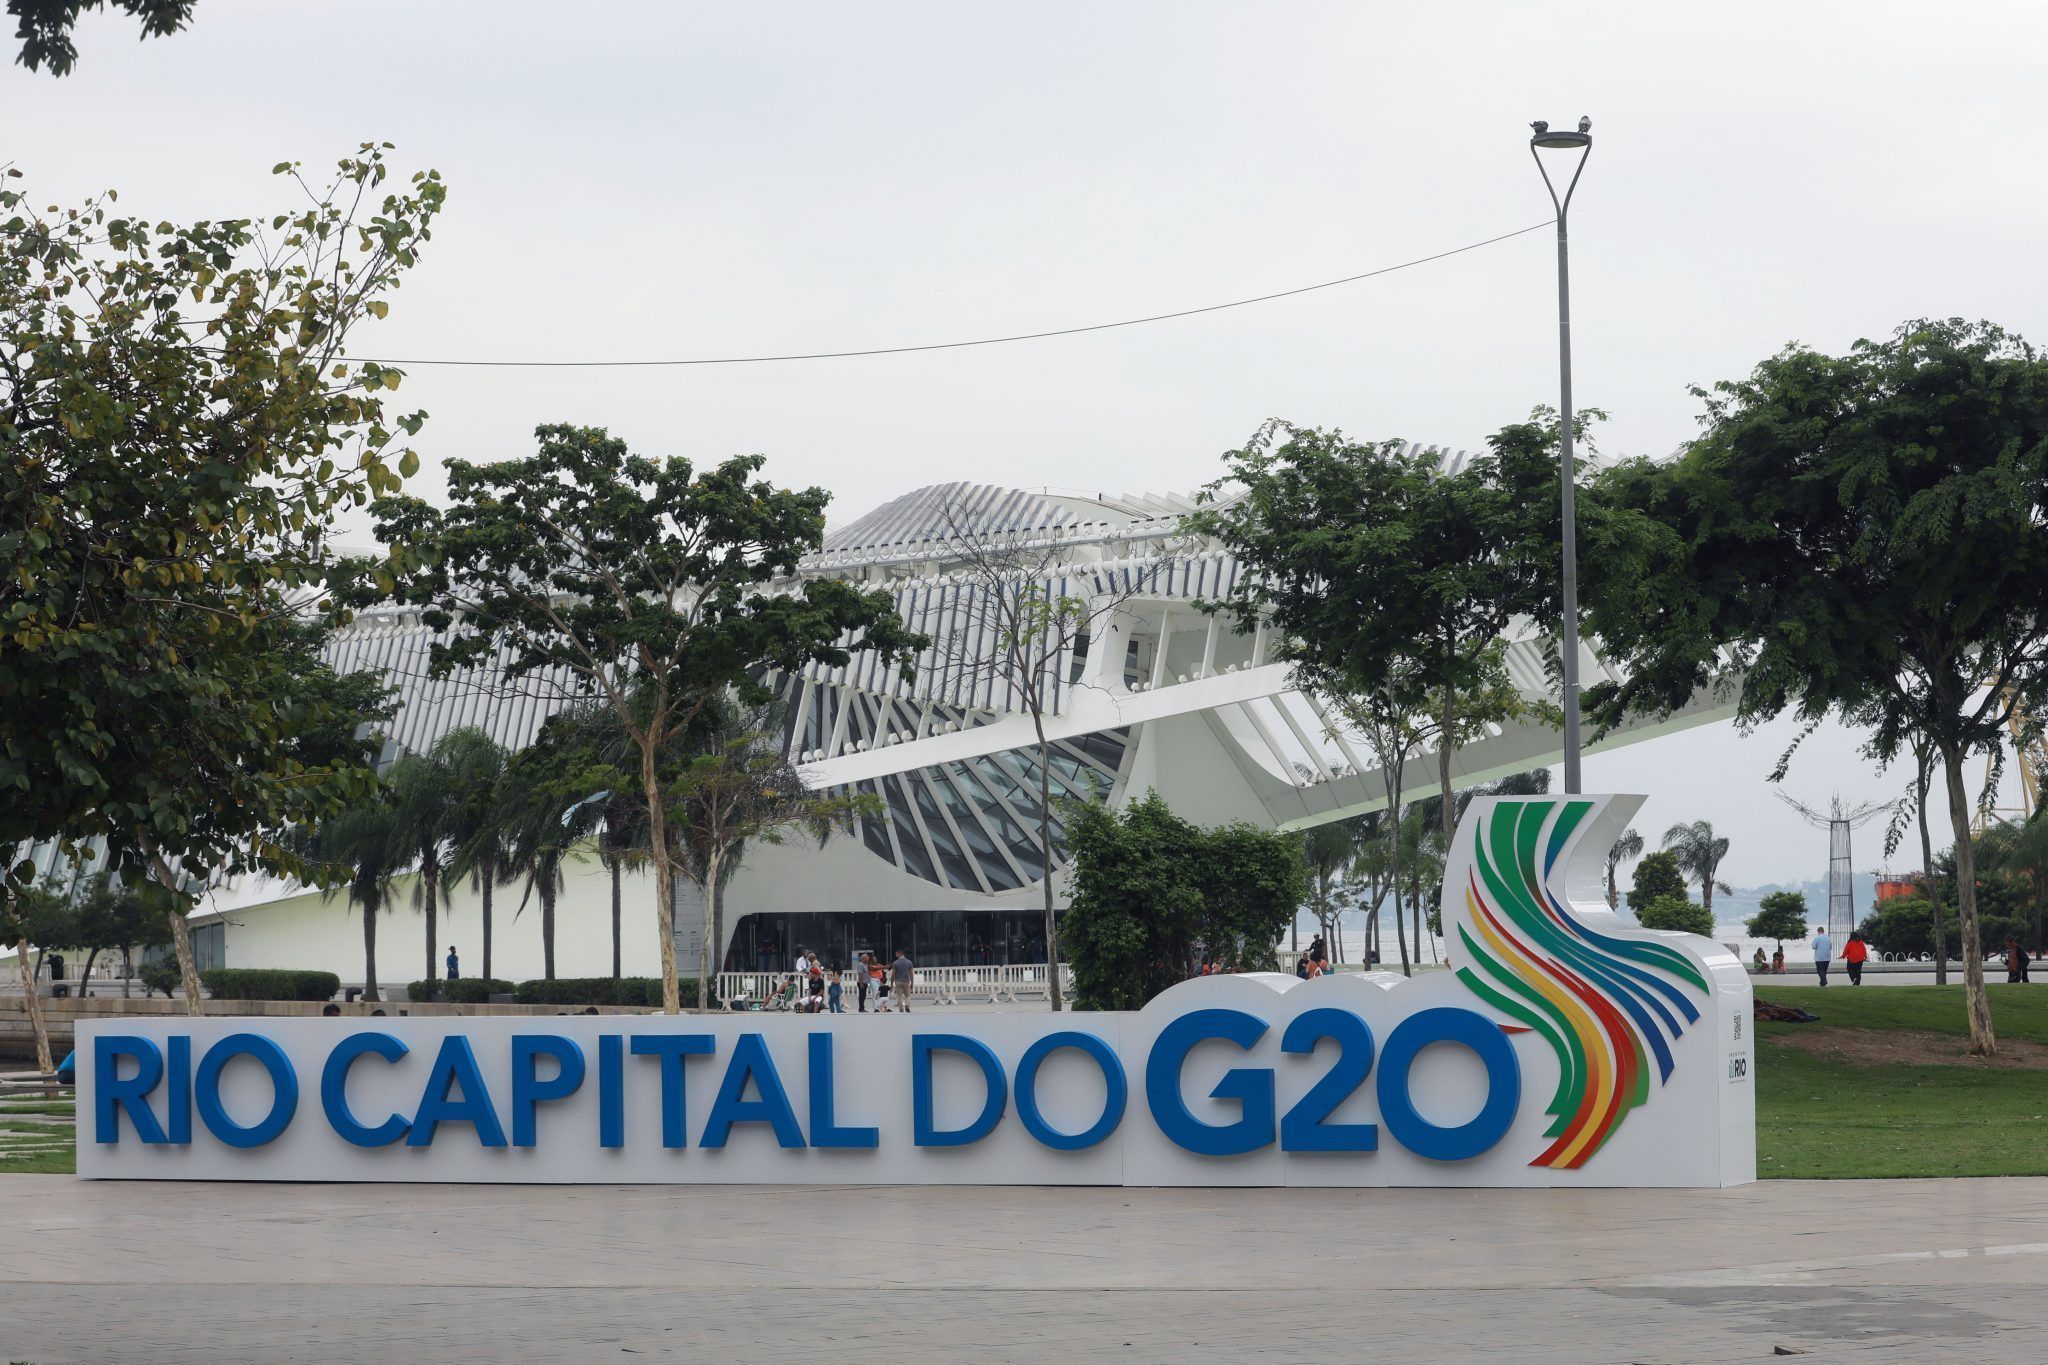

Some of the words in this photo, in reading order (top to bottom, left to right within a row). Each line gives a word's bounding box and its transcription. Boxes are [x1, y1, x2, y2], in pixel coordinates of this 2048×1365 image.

[95, 1033, 299, 1149] RIO
[321, 1031, 880, 1149] CAPITAL
[912, 1031, 1128, 1151] DO
[1146, 1007, 1522, 1162] G20
[1734, 1058, 1746, 1078] RIO
